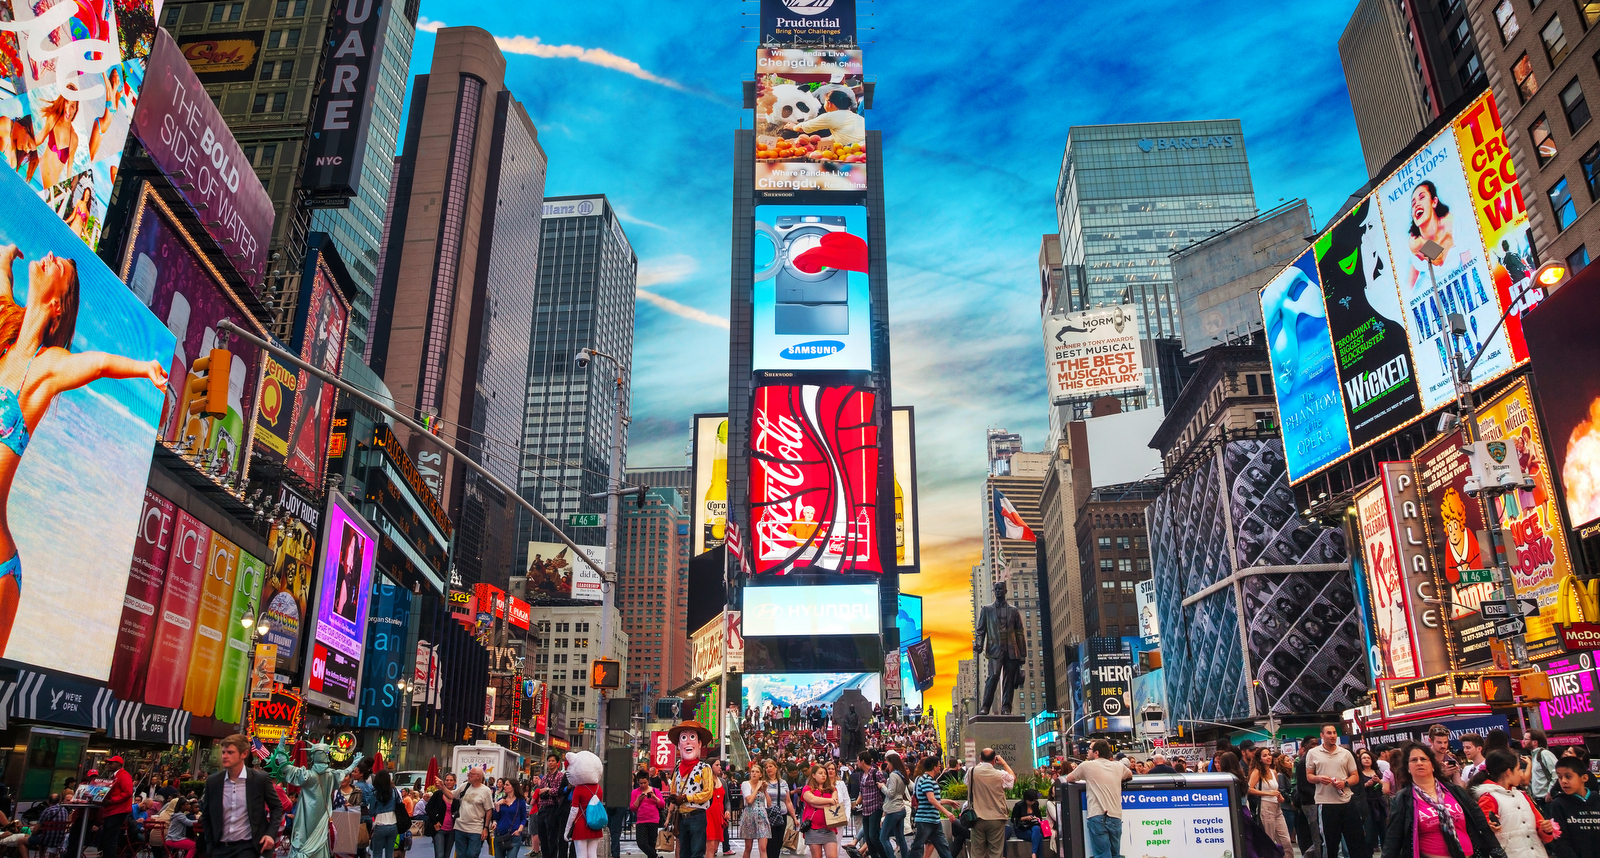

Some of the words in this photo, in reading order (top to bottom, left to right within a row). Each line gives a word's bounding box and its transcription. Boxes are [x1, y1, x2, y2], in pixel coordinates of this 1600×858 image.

[776, 17, 840, 28] Prudential
[758, 58, 817, 69] Chengdu,
[172, 75, 203, 139] THE
[200, 125, 240, 194] BOLD
[1157, 136, 1234, 151] BARCLAYS
[316, 155, 343, 167] NYC
[1396, 162, 1414, 183] THE
[1414, 146, 1433, 168] FUN
[758, 178, 821, 190] Chengdu,
[1388, 176, 1415, 205] NEVER
[1416, 148, 1448, 182] STOPS!
[160, 113, 199, 179] SIDE
[198, 166, 219, 201] OF
[218, 190, 258, 265] WATER
[1336, 316, 1377, 349] "BROADWAY'S
[788, 346, 838, 354] SAMSUNG
[1055, 342, 1081, 351] WINNER
[1056, 349, 1082, 360] BEST
[1086, 343, 1135, 355] MUSICAL
[1340, 334, 1364, 358] BIGGEST
[1341, 328, 1386, 366] BLOCKBUSTER"
[1052, 357, 1090, 372] "THE
[1093, 352, 1135, 367] BEST
[1058, 366, 1116, 382] MUSICAL
[1118, 364, 1137, 375] OF
[1058, 380, 1084, 391] THIS
[1086, 373, 1143, 387] CENTURY."
[260, 375, 283, 427] Q
[1300, 390, 1315, 405] The
[1286, 390, 1338, 433] PHANTOM
[1504, 408, 1530, 434] MUELLER
[1297, 427, 1332, 456] OPERA
[756, 408, 804, 554] Coca-Cola
[286, 494, 302, 516] JOY
[137, 501, 171, 551] ICE
[578, 516, 588, 526] 46
[176, 524, 206, 570] ICE
[586, 548, 595, 558] By
[1397, 474, 1438, 629] PALACE
[1510, 536, 1555, 576] WORK
[209, 544, 235, 586] ICE
[238, 562, 261, 600] ICE
[1461, 574, 1469, 582] W
[1470, 572, 1481, 582] 46
[1521, 576, 1531, 587] You
[1530, 574, 1540, 585] Can
[1539, 569, 1548, 581] Get
[268, 609, 299, 629] MOTOWN
[1487, 606, 1504, 614] ONE
[1500, 625, 1508, 635] ONE
[312, 658, 326, 680] CNN
[1098, 665, 1133, 682] HERO
[65, 692, 83, 703] WE'RE
[1101, 688, 1117, 696] JUNE
[1118, 687, 1123, 696] 6
[62, 702, 79, 712] OPEN
[256, 700, 296, 721] ROXY
[512, 676, 522, 742] HERSHEYS
[1547, 692, 1595, 719] SQUARE
[152, 713, 168, 724] WE'RE
[150, 724, 164, 733] OPEN
[1370, 736, 1380, 745] BOX
[1380, 734, 1396, 744] OFFICE
[1395, 732, 1409, 741] HERE
[656, 734, 671, 766] tkts
[1138, 794, 1168, 803] Green
[1171, 794, 1190, 802] and
[1192, 792, 1223, 802] Clean!
[1142, 818, 1172, 827] recycle
[1192, 816, 1224, 826] recycle
[1194, 826, 1224, 834] bottles
[1152, 828, 1163, 836] all
[1196, 836, 1203, 844] &
[1146, 838, 1171, 847] paper
